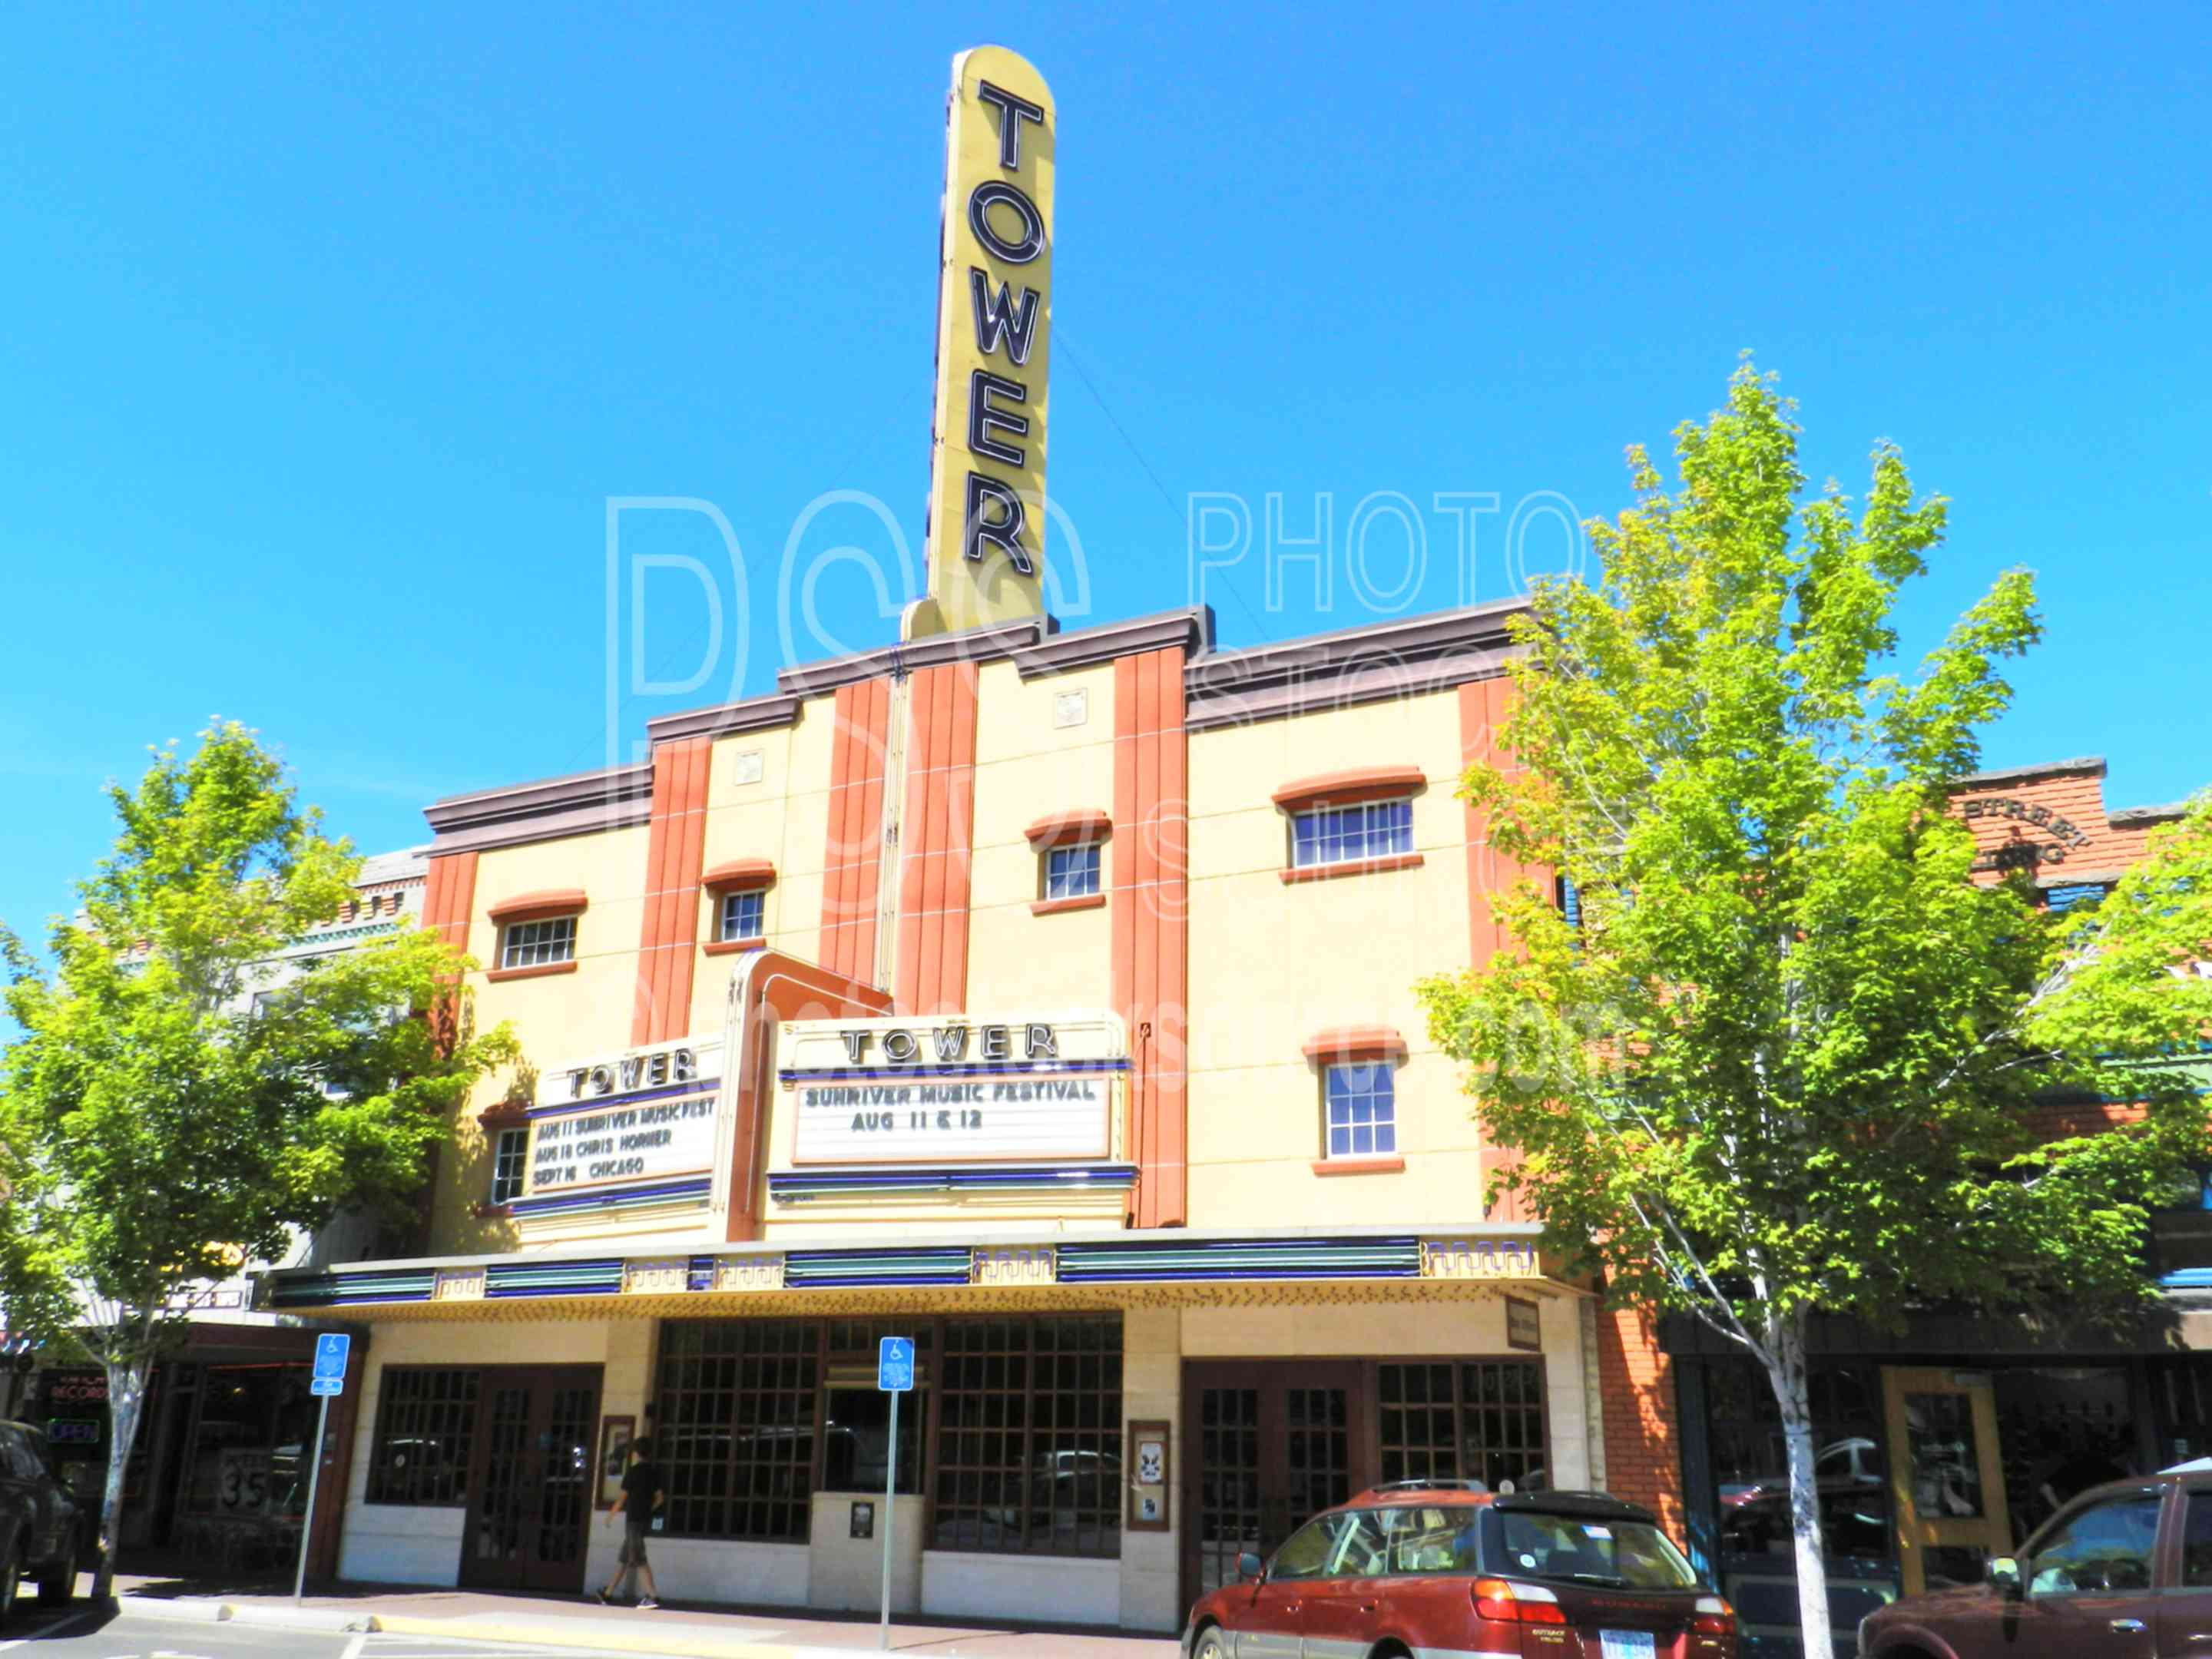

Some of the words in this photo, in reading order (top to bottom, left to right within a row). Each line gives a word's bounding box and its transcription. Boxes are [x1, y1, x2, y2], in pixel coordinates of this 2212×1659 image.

[963, 78, 1045, 578] TOWER
[839, 1022, 1058, 1065] TOWER
[567, 1048, 698, 1098] TOWER
[806, 1085, 911, 1108] SUNRIVER
[919, 1083, 984, 1104] MUSIC
[993, 1080, 1096, 1102] FESTIVAL
[641, 1103, 680, 1124] MUSIC
[682, 1097, 715, 1117] FEST
[851, 1111, 893, 1132] AUG
[911, 1111, 927, 1131] 11
[960, 1109, 982, 1130] 12
[576, 1137, 614, 1157] CHRIS
[533, 1166, 562, 1186] SEPT
[589, 1157, 644, 1179] CHICAGO
